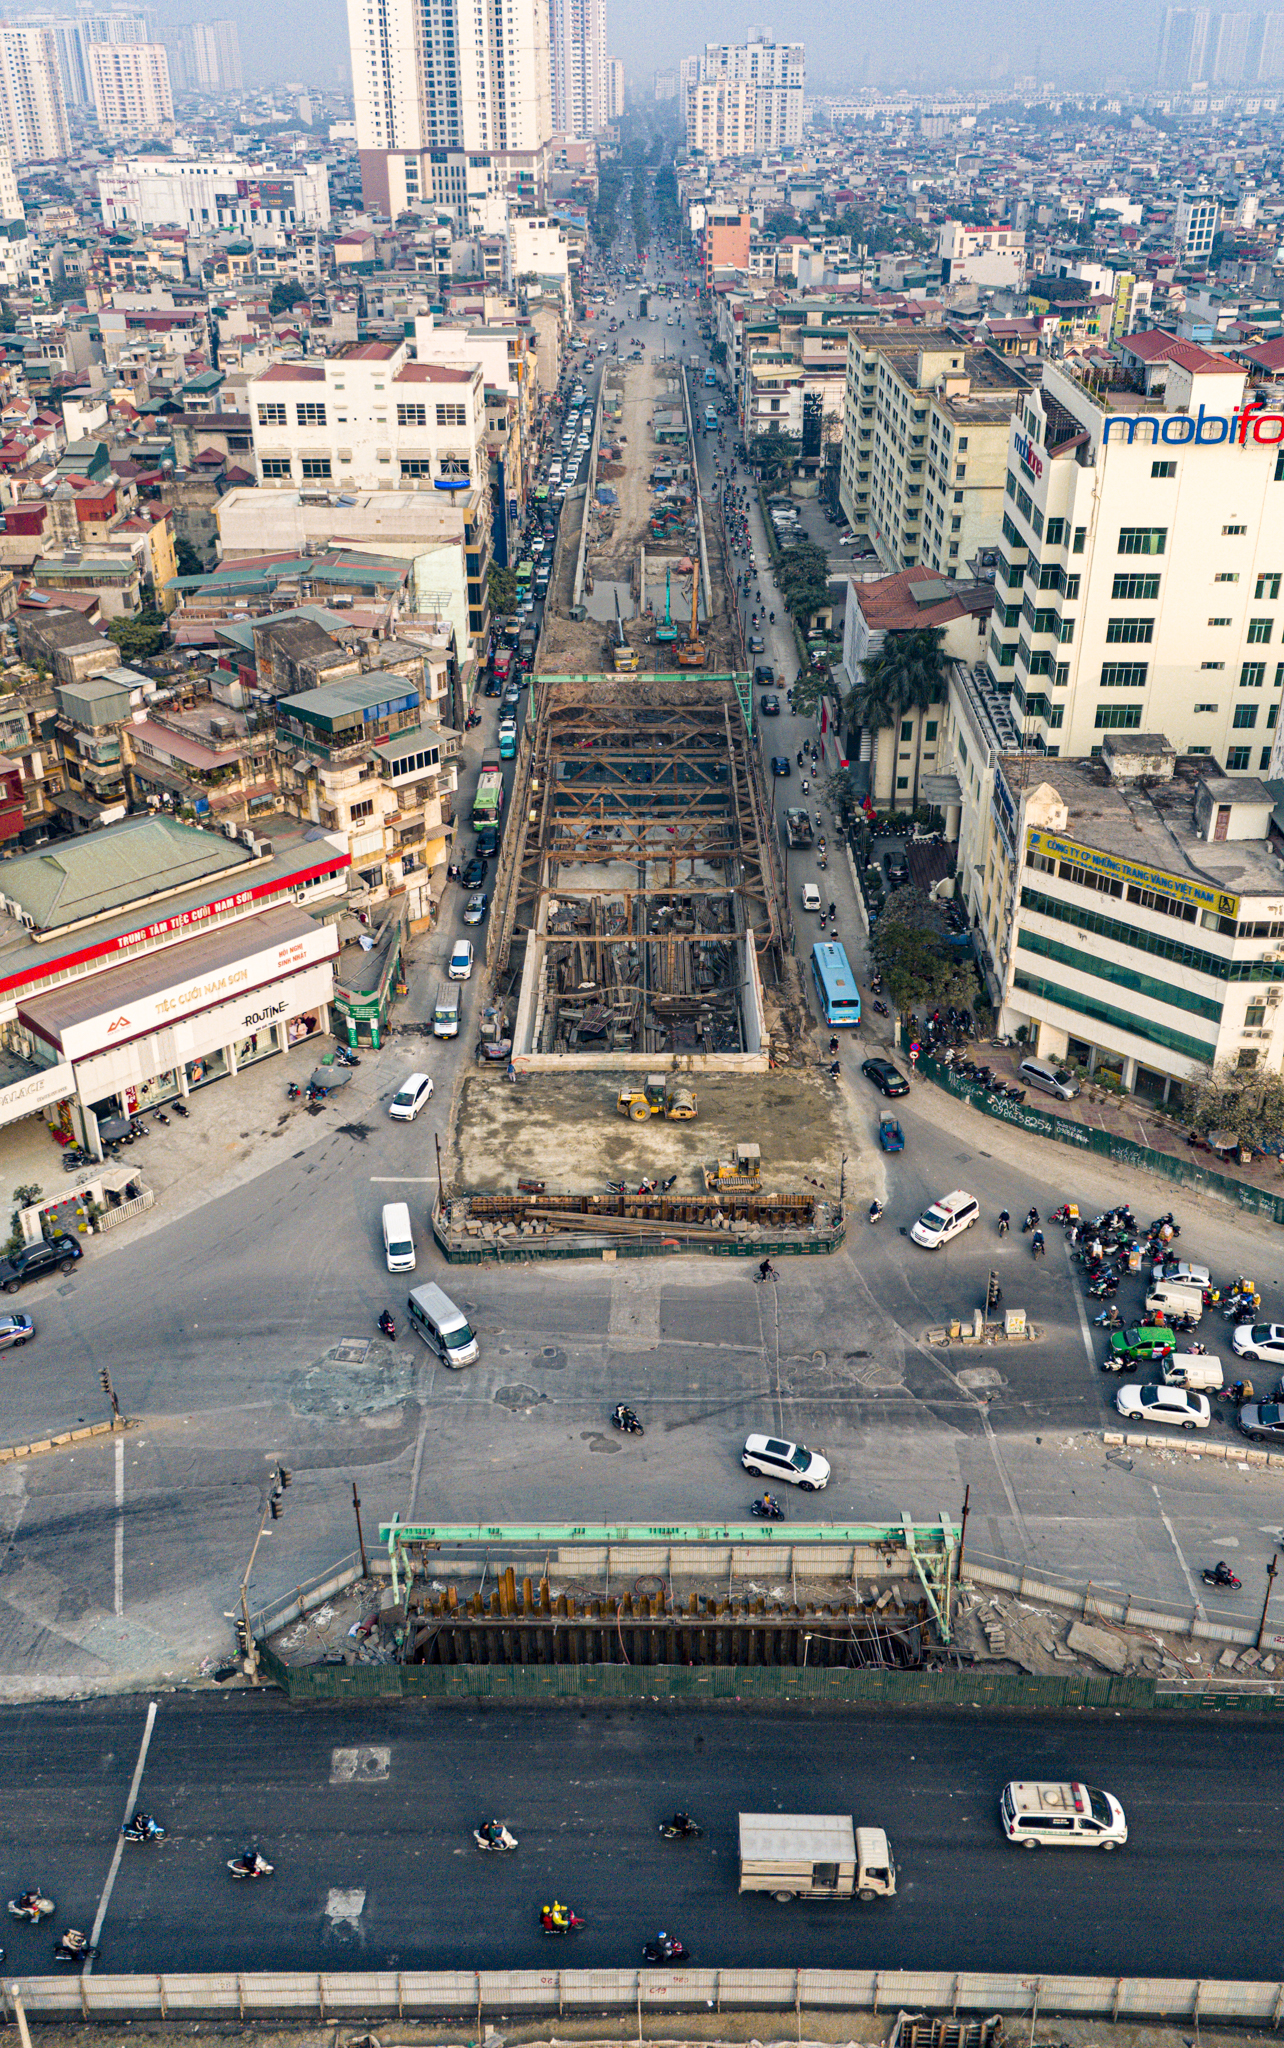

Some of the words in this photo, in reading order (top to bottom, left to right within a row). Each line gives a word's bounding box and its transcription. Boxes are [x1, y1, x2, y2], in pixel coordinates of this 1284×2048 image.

[1014, 432, 1043, 480] mobifone
[1047, 839, 1069, 855] CÔNG
[1070, 847, 1080, 858] TY
[1081, 851, 1091, 861] CP
[1092, 855, 1121, 874] NHỮNG
[1121, 864, 1149, 881] TRANG
[1150, 873, 1173, 889] VÀNG
[1174, 881, 1193, 896] VIỆT
[1194, 888, 1214, 903] NAM
[1060, 855, 1103, 873] VIETNAM
[1104, 871, 1144, 887] YELLOW
[1145, 884, 1177, 898] PAGES
[117, 929, 147, 948] TRUNG
[149, 922, 168, 937] TÂM
[170, 914, 190, 928] TIỆC
[214, 898, 234, 913] NAM
[236, 891, 253, 904] SƠN
[277, 958, 291, 968] SINH
[155, 999, 176, 1014] TIỆC
[178, 986, 202, 1005] CƯỚI
[204, 978, 227, 995] NAM
[227, 968, 248, 986] SƠN
